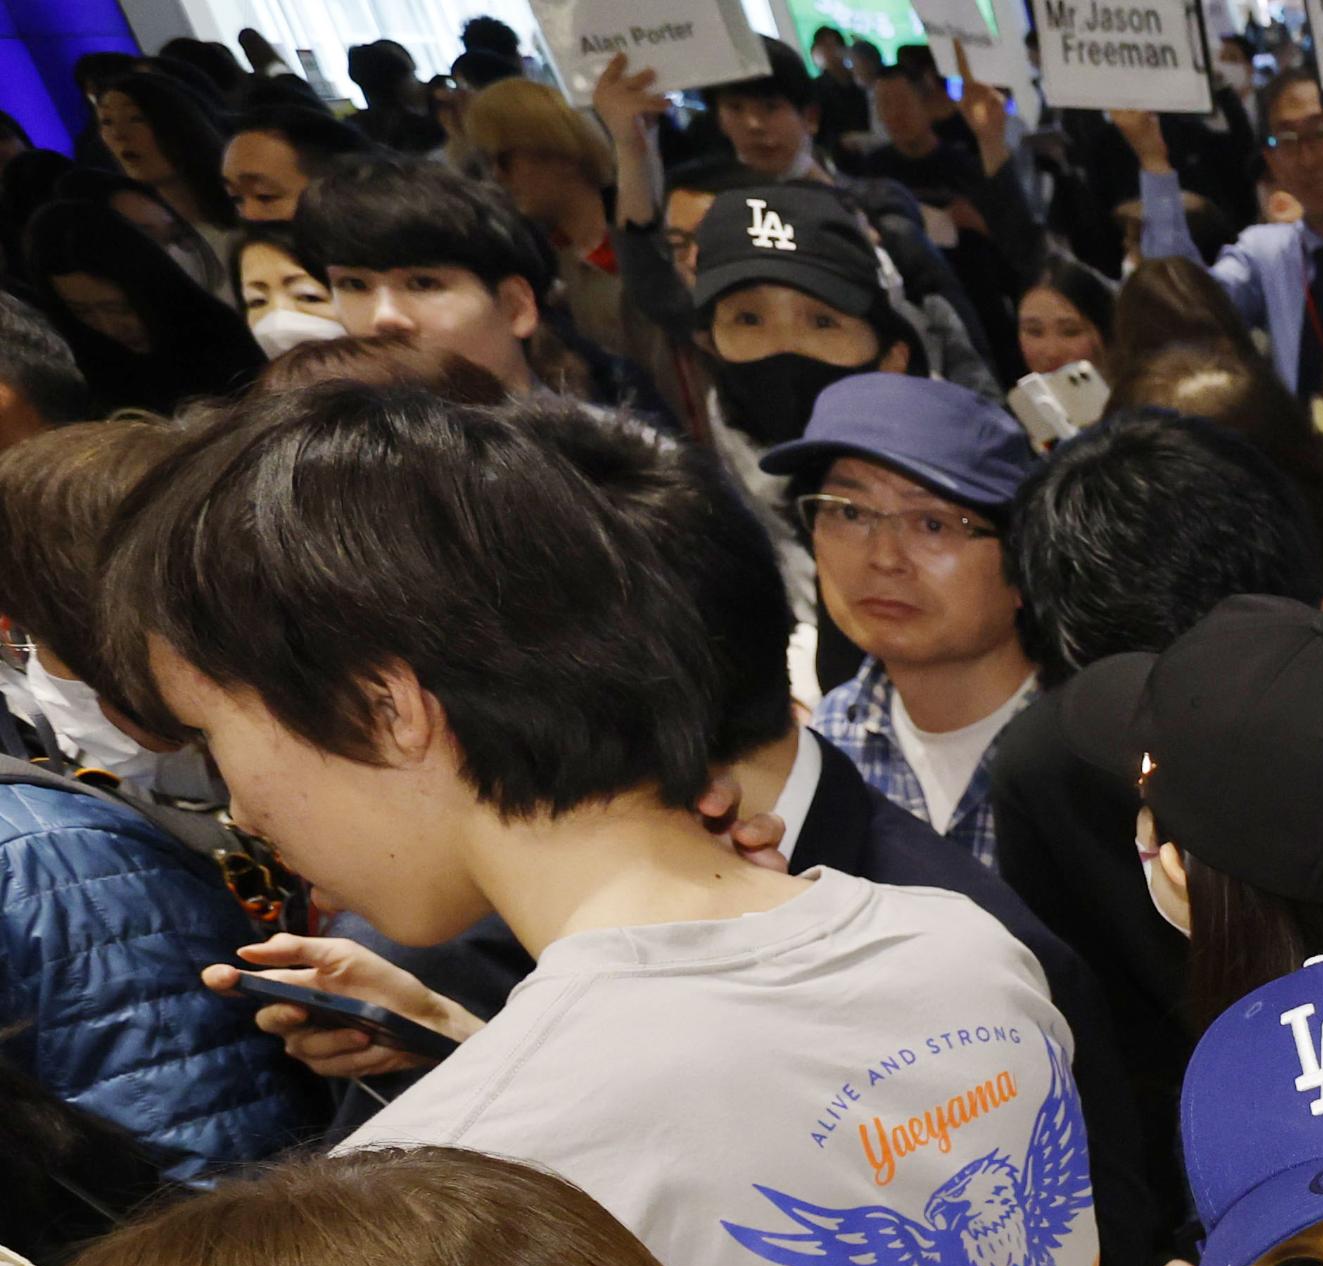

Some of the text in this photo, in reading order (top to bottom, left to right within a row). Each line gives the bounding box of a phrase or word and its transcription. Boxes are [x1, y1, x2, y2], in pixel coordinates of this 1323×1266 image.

[581, 22, 694, 56] Alan Porter
[1062, 33, 1177, 68] Freeman
[746, 198, 797, 252] LA
[811, 1025, 1022, 1149] ALIVE AND STRONG
[859, 1070, 1018, 1187] Yaeyama
